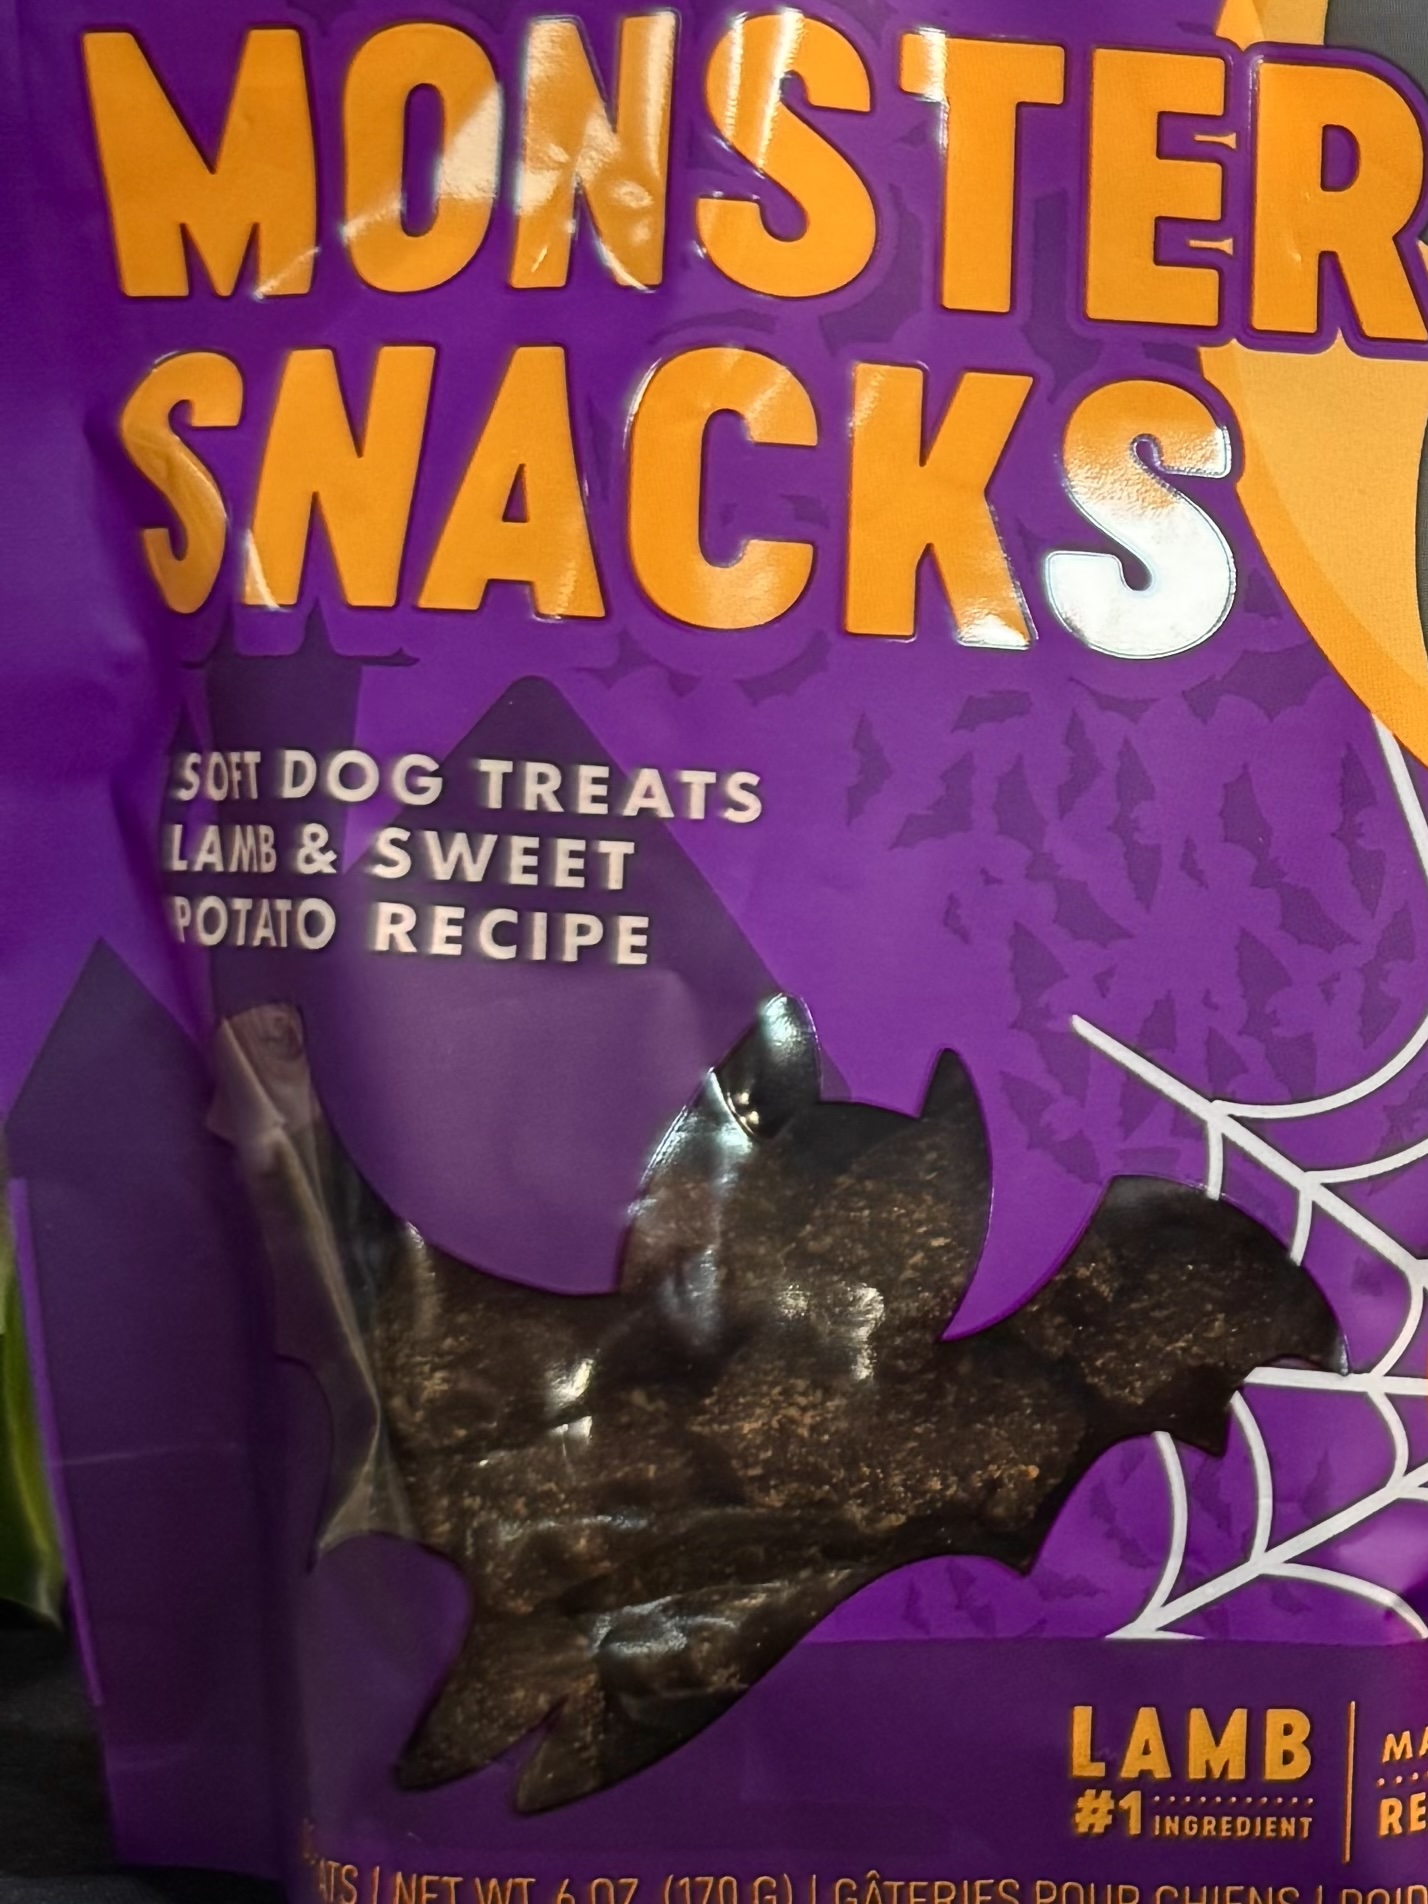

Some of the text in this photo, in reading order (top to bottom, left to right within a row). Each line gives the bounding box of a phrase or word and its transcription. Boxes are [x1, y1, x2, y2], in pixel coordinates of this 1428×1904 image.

[120, 345, 1237, 659] SNACKS
[175, 749, 763, 824] SOFT DOG TREATS
[168, 822, 635, 891] LAMB & SWEET
[173, 895, 650, 966] POTATO RECIPE
[1070, 1705, 1312, 1781] LAMB
[1073, 1788, 1313, 1839] #1 INGREDIENT
